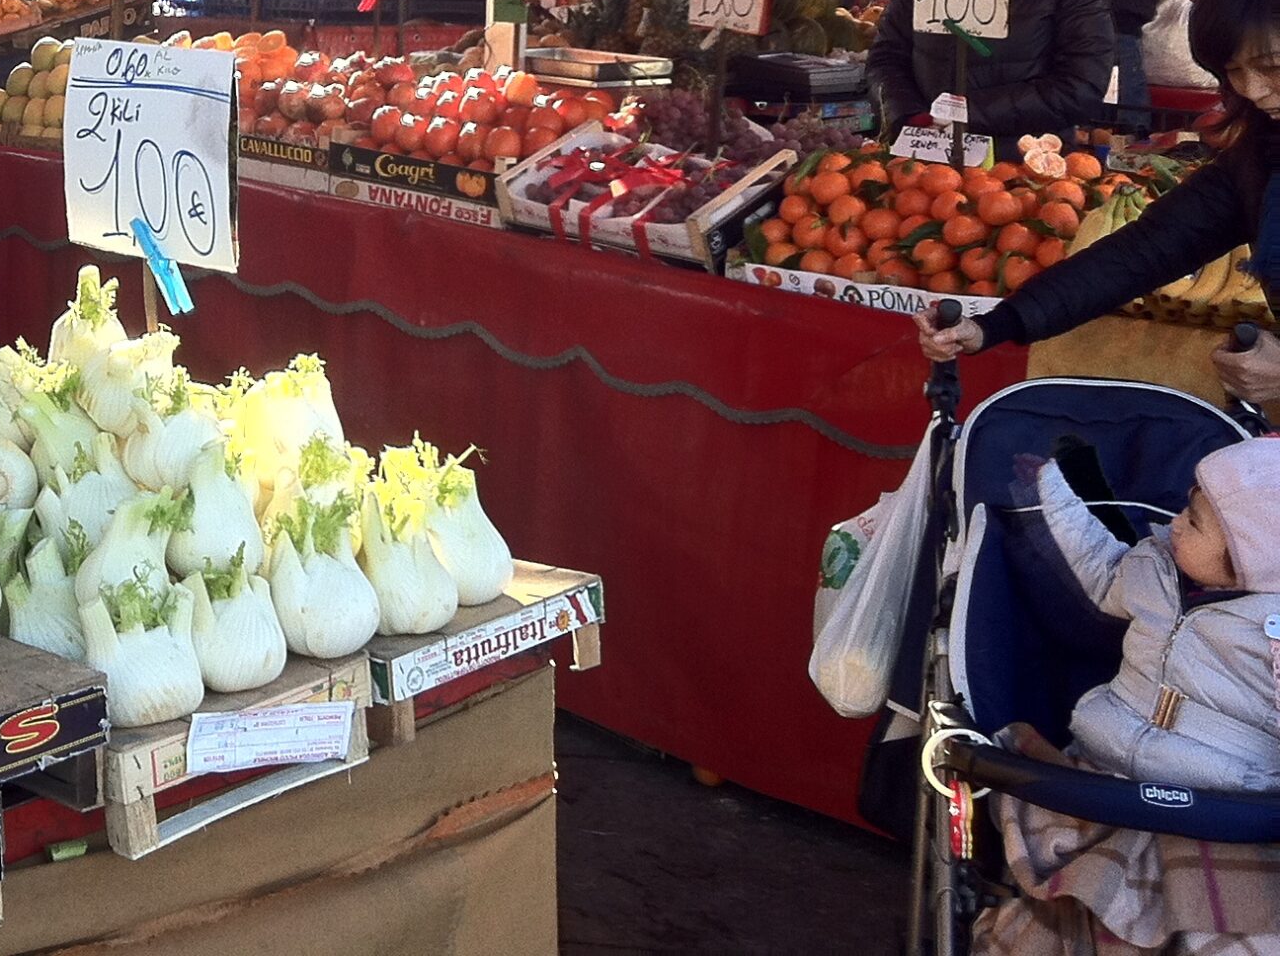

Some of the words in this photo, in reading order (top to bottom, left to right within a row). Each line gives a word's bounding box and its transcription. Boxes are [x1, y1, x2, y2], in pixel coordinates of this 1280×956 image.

[75, 91, 109, 142] 2
[240, 137, 313, 164] CAVALLUCCIO
[374, 153, 436, 185] Coagri
[366, 184, 453, 220] FONTANA
[451, 617, 547, 668] Italfrutta
[1145, 786, 1189, 803] chicco
